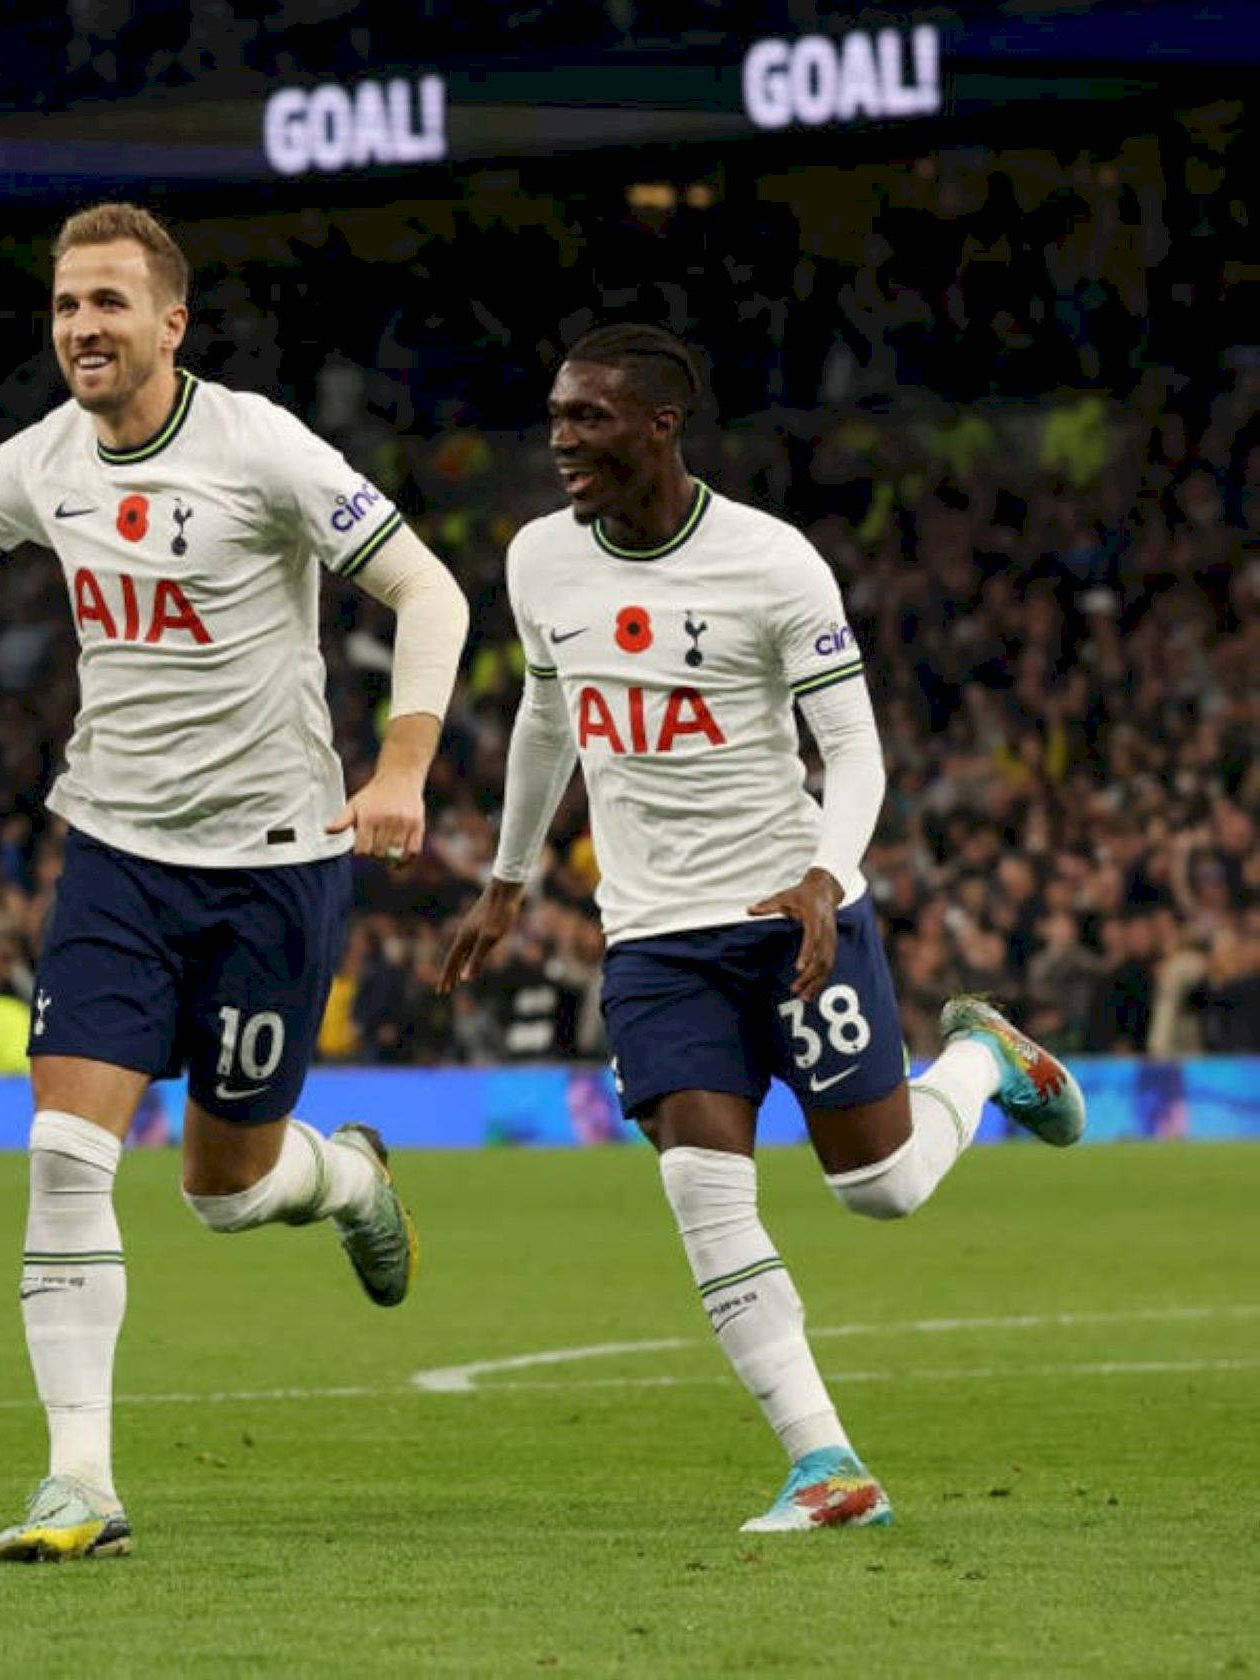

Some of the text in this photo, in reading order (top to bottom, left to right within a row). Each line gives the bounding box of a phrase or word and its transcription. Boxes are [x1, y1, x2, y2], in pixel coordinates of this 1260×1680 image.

[743, 25, 940, 128] GOAL!
[263, 75, 445, 174] GOAL!
[74, 568, 214, 645] AIA
[579, 686, 726, 755] AIA
[216, 1005, 285, 1080] 10
[778, 983, 872, 1068] 38
